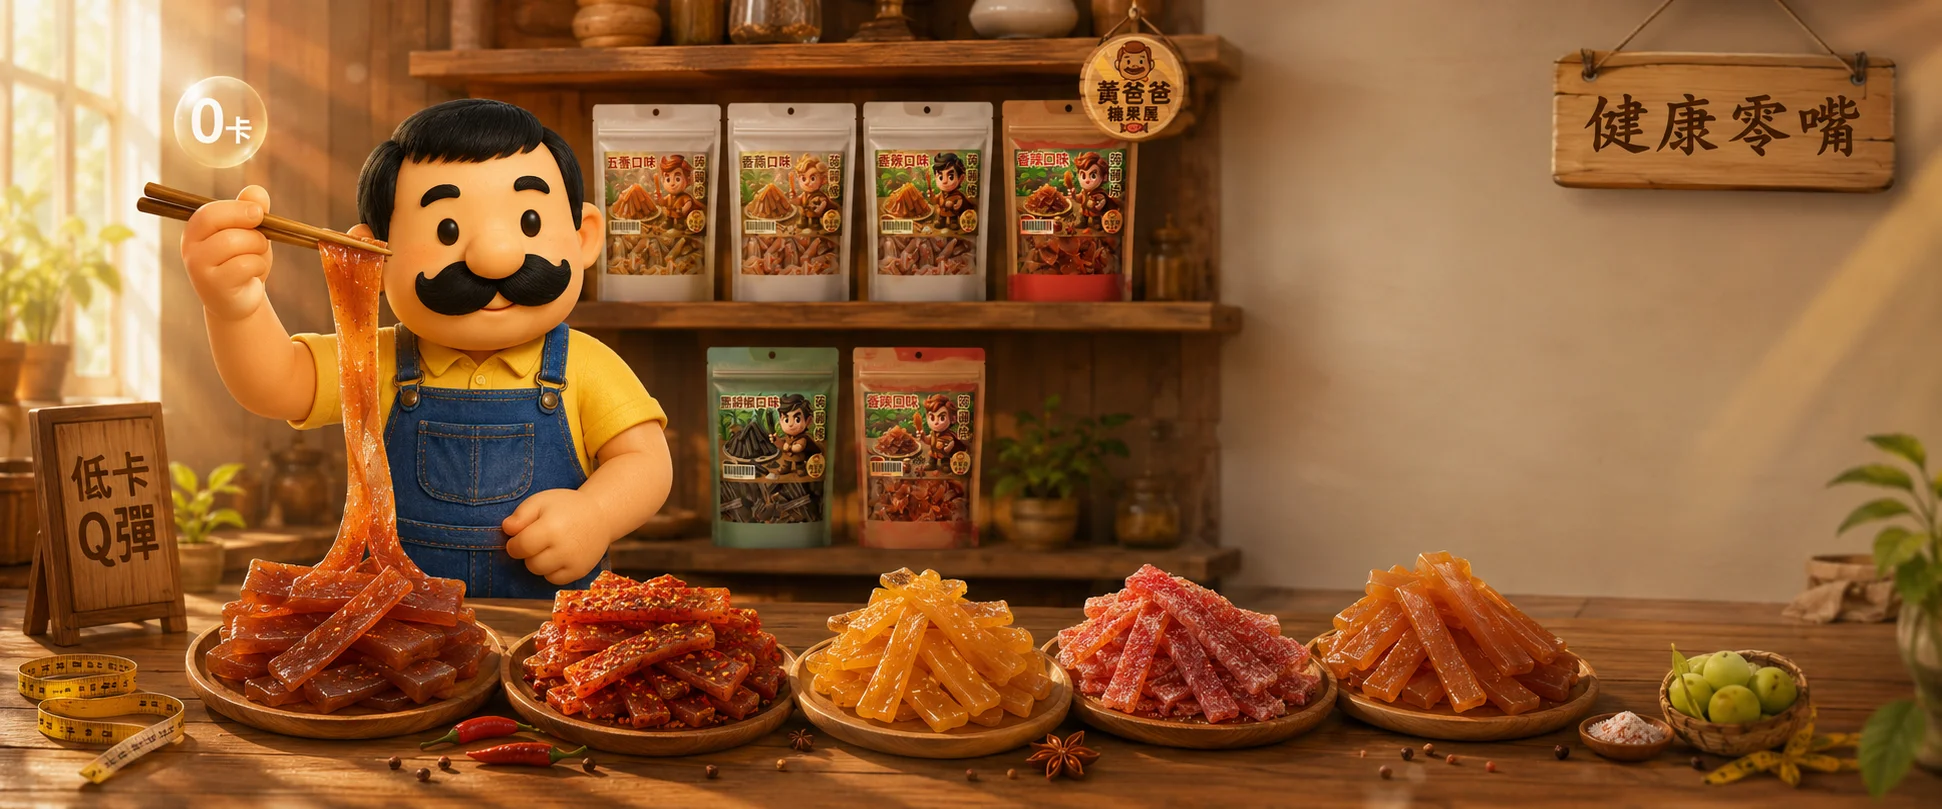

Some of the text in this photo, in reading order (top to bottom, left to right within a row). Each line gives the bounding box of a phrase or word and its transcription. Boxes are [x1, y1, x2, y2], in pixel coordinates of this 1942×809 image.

[1097, 80, 1171, 104] 黃爸爸
[1584, 93, 1860, 157] 健康零嘴
[1017, 152, 1070, 168] 香辣口味
[71, 451, 149, 502] 低卡
[79, 504, 159, 567] Q彈
